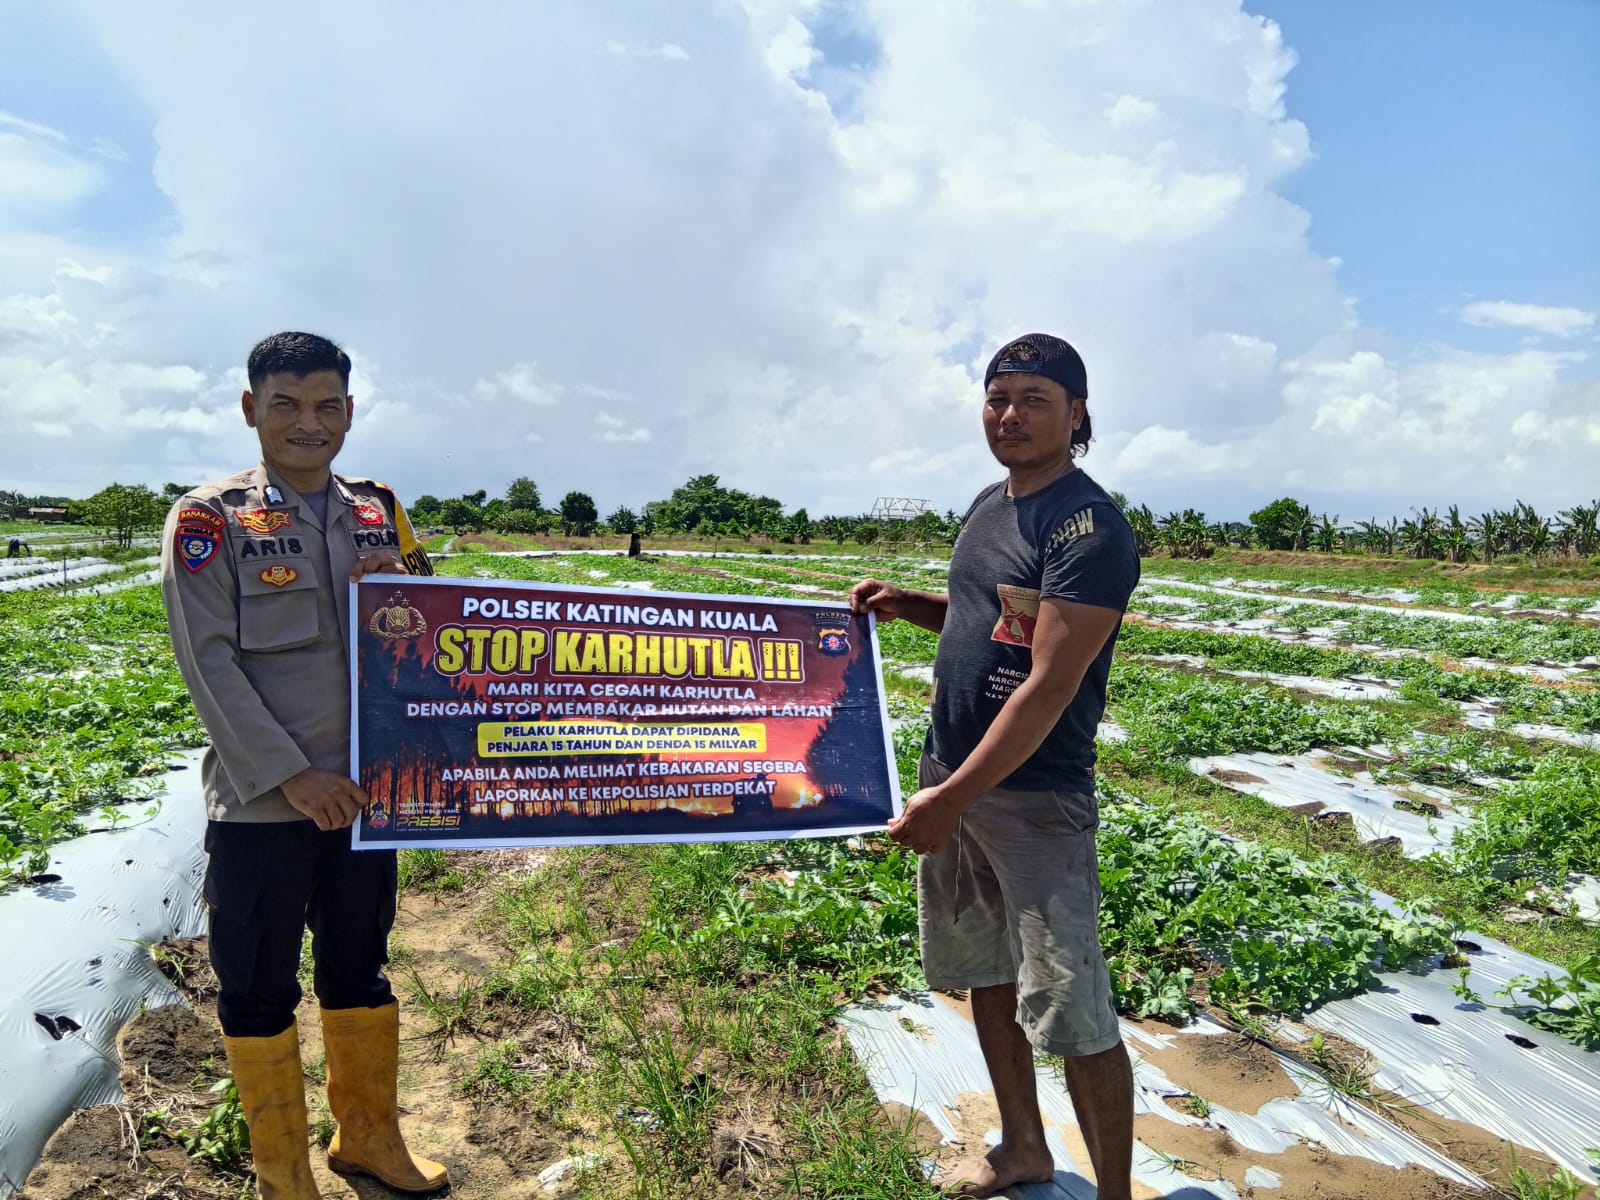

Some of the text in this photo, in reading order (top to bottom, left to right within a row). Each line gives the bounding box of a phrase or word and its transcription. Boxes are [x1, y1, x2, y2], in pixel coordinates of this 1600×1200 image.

[241, 537, 303, 558] ARIS
[463, 597, 779, 632] POLSEK KATINGAN KUALA
[437, 627, 802, 680] STOP KARHUTLA !!!
[487, 683, 757, 700] MARI KITA CEGAH KARHUTLA
[407, 702, 833, 718] DENGAN STOP MEMBAKAR HUTAN DAN LAHAN
[504, 725, 740, 737] PELAKU KARHUTLA DAPAT DIPIDANA
[487, 739, 757, 753] PENJARA 15 TAHUN DAN DENDA 15 MILYAR
[442, 761, 807, 782] APABILA ANDA MELIHAT KEBAKARAN SEGERA
[475, 780, 776, 802] LAPORKAN KE KEPOLISIAN TERDEKAT
[396, 815, 461, 827] PRESISI
